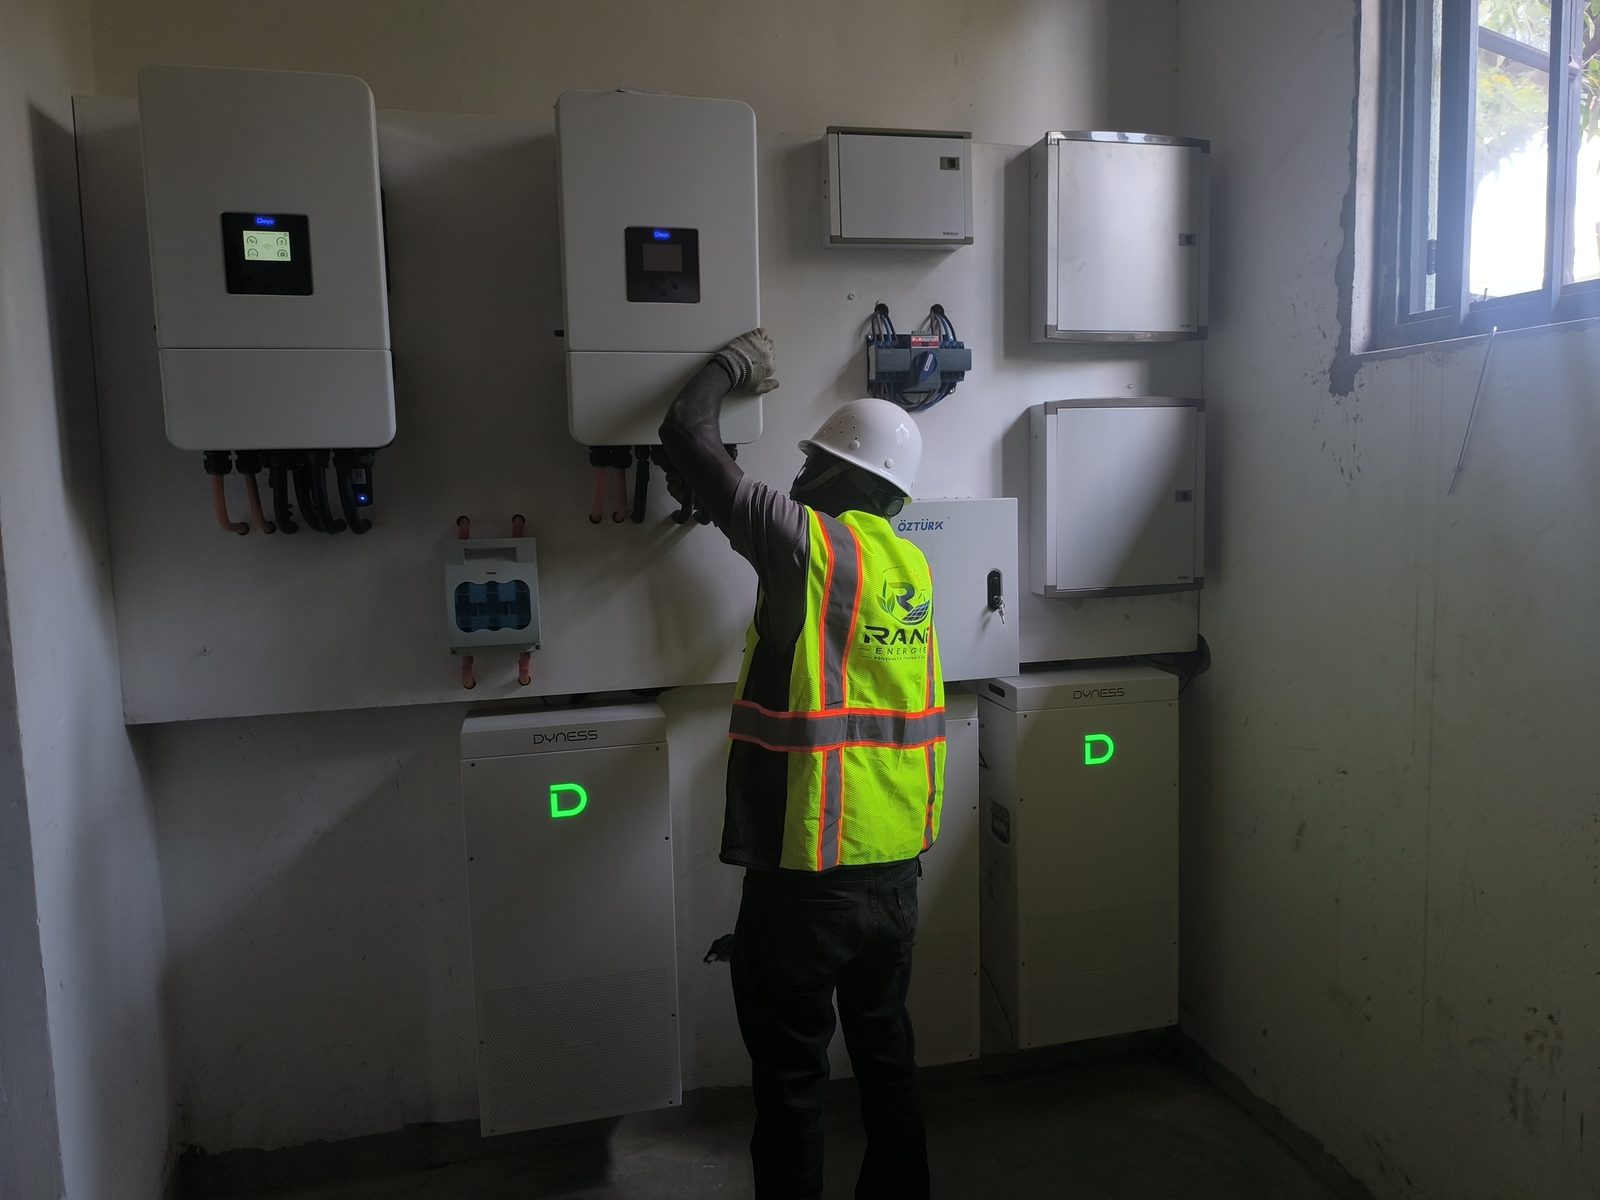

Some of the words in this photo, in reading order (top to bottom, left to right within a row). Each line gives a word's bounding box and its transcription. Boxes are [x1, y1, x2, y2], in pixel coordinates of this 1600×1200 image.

[898, 519, 944, 531] ÖZTÜRK
[1073, 688, 1125, 699] DYNESS
[533, 730, 598, 744] DYNESS
